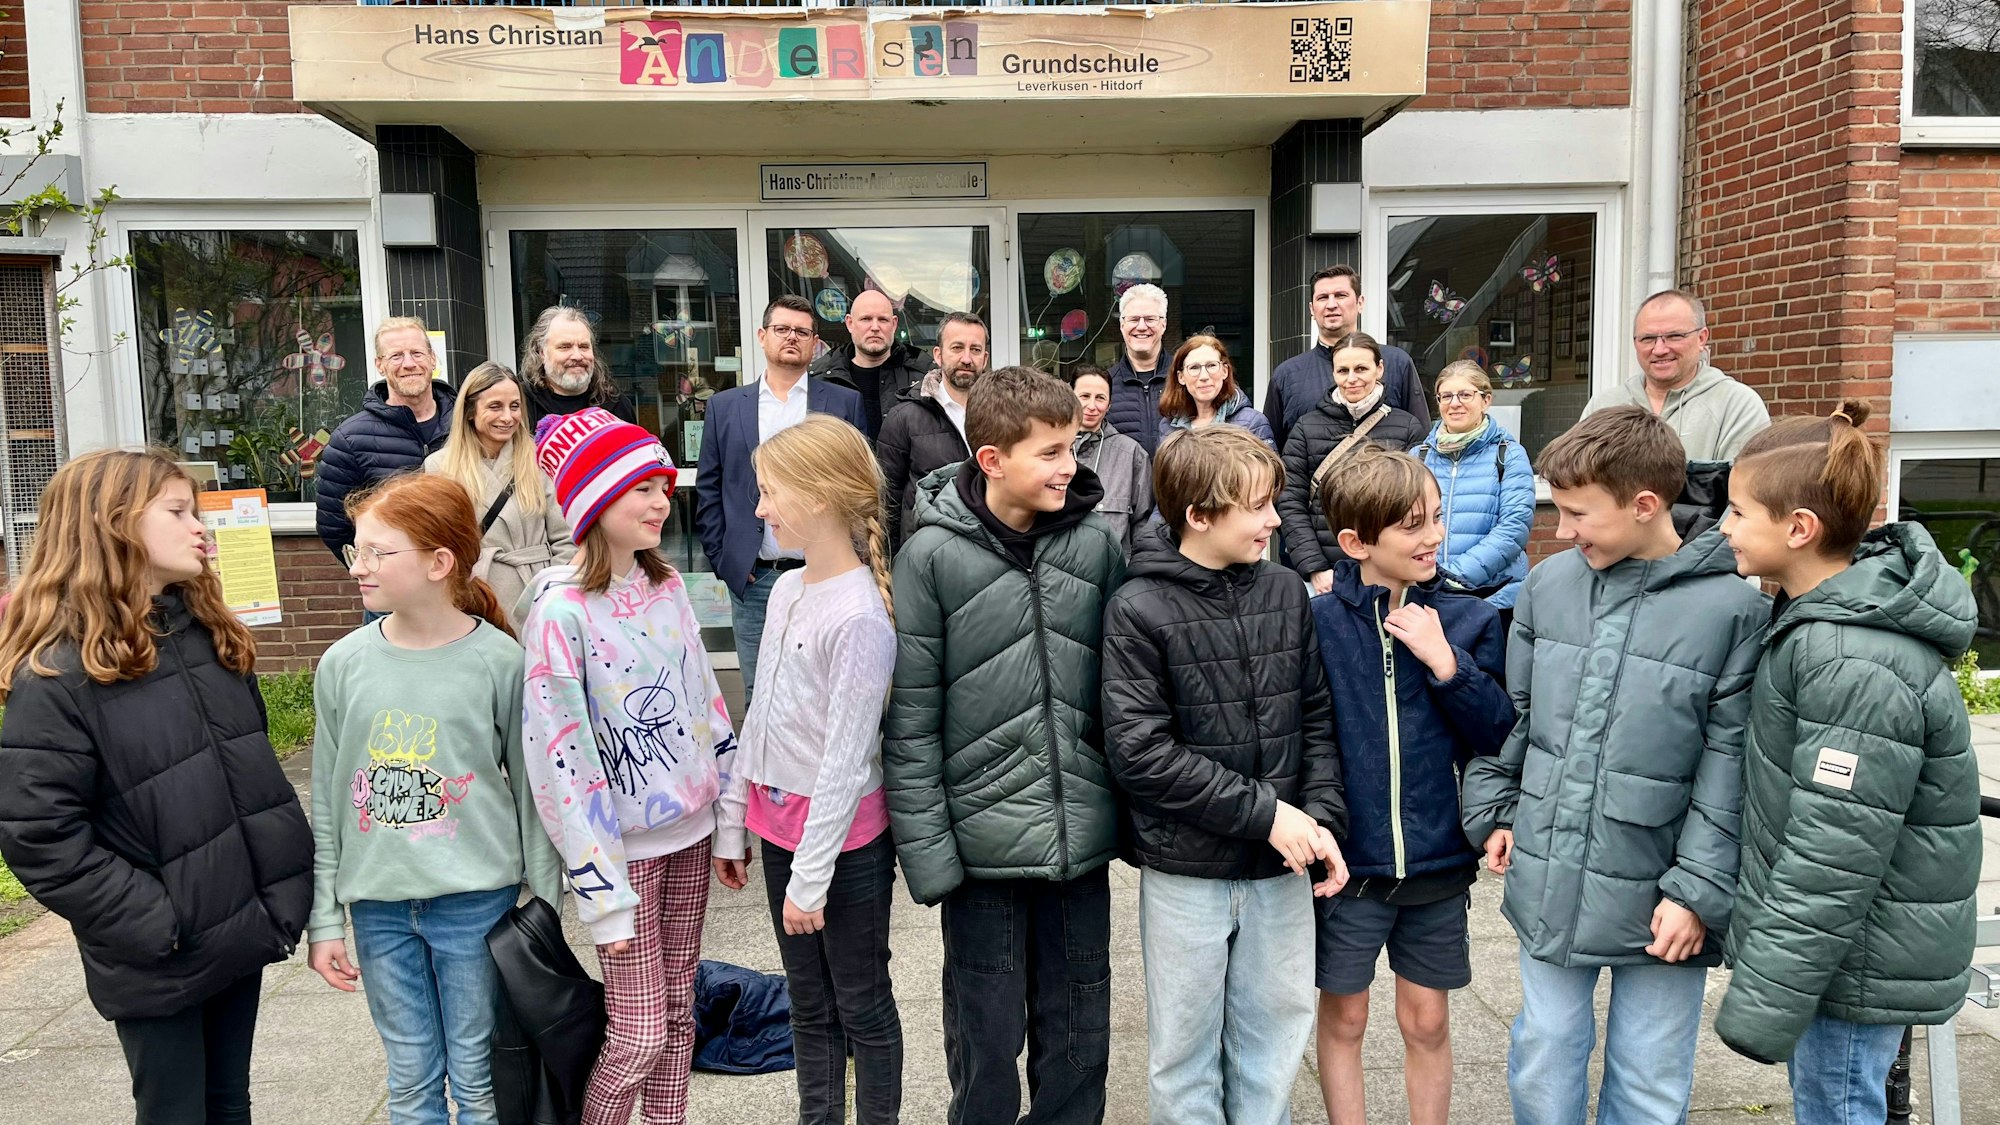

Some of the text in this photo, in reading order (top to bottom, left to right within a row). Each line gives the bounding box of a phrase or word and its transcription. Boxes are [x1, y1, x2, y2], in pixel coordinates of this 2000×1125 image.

[414, 24, 480, 45] Hans
[488, 23, 603, 46] Christian
[1001, 53, 1160, 74] Grundschule
[1016, 80, 1089, 92] Leverkusen
[1100, 79, 1144, 91] Hitdorf
[366, 793, 445, 824] POWER
